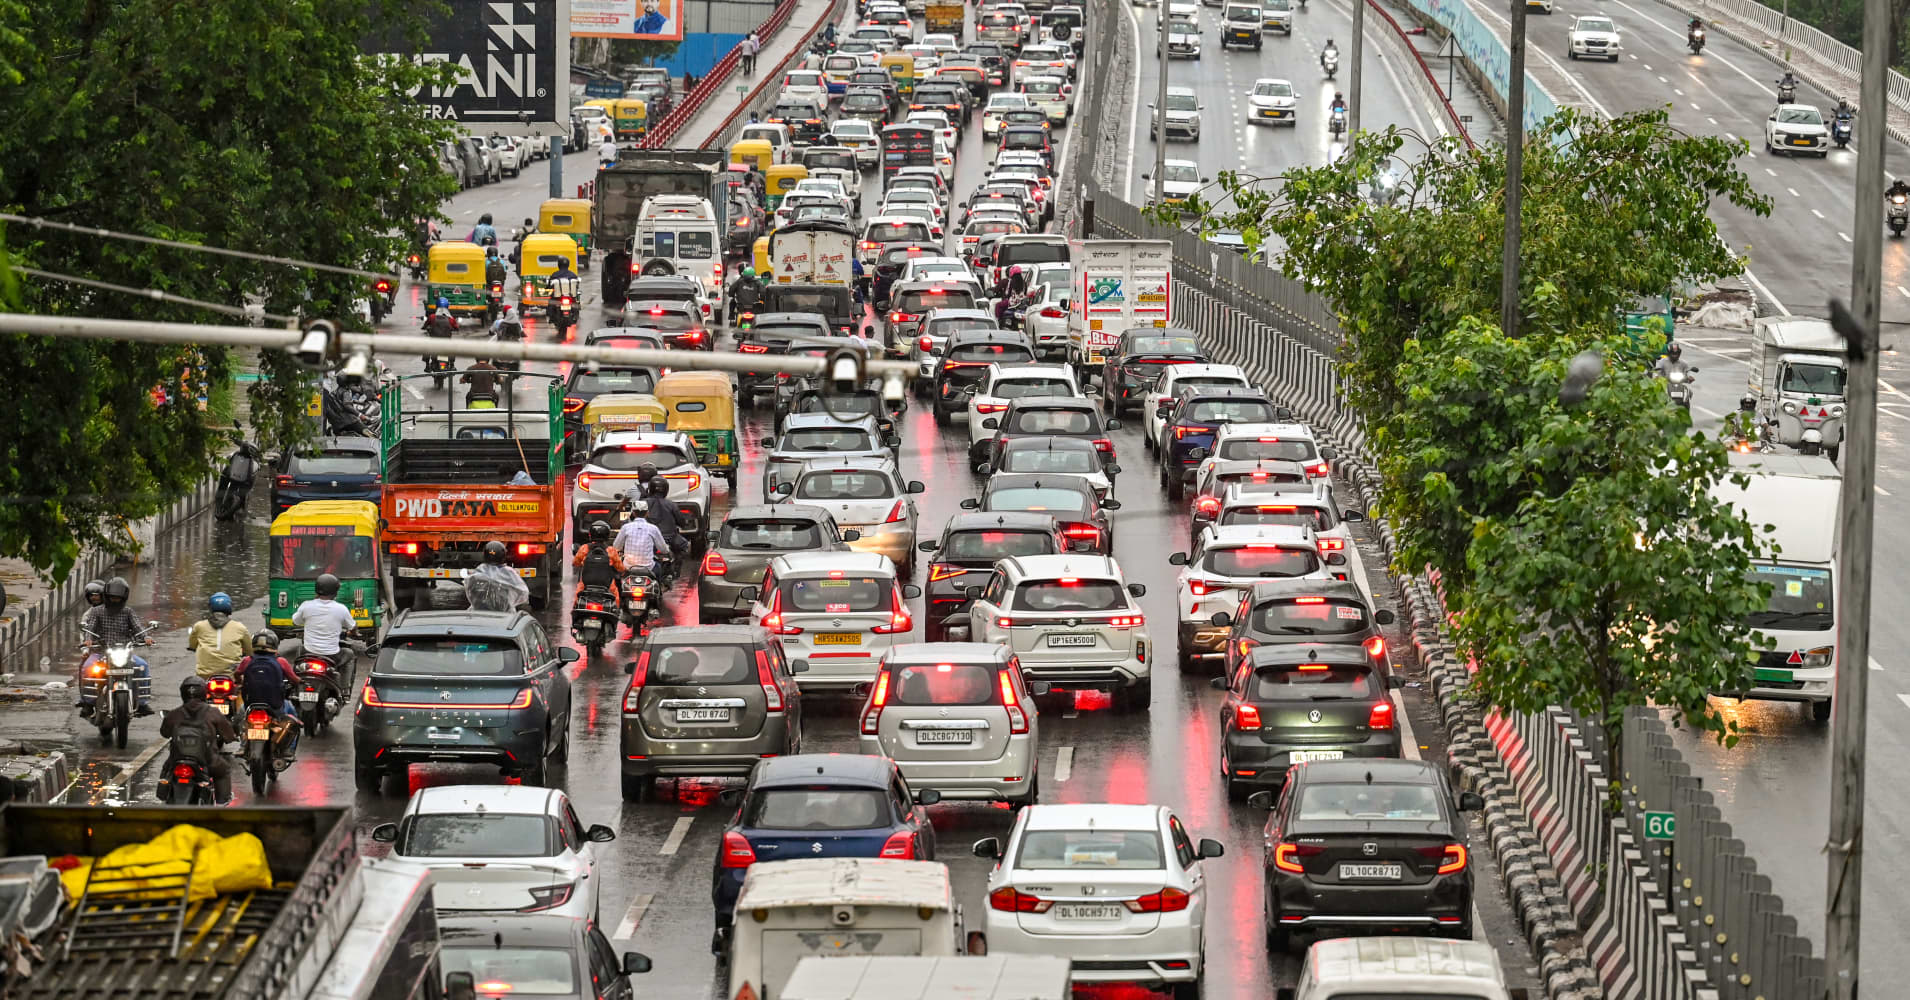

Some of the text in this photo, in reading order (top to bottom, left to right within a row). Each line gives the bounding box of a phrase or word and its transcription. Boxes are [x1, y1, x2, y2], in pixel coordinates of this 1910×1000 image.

[357, 53, 536, 98] UTANI
[395, 498, 442, 518] PWD
[441, 501, 497, 516] TATA
[681, 711, 691, 719] DL
[1061, 907, 1120, 918] DL10CH9712
